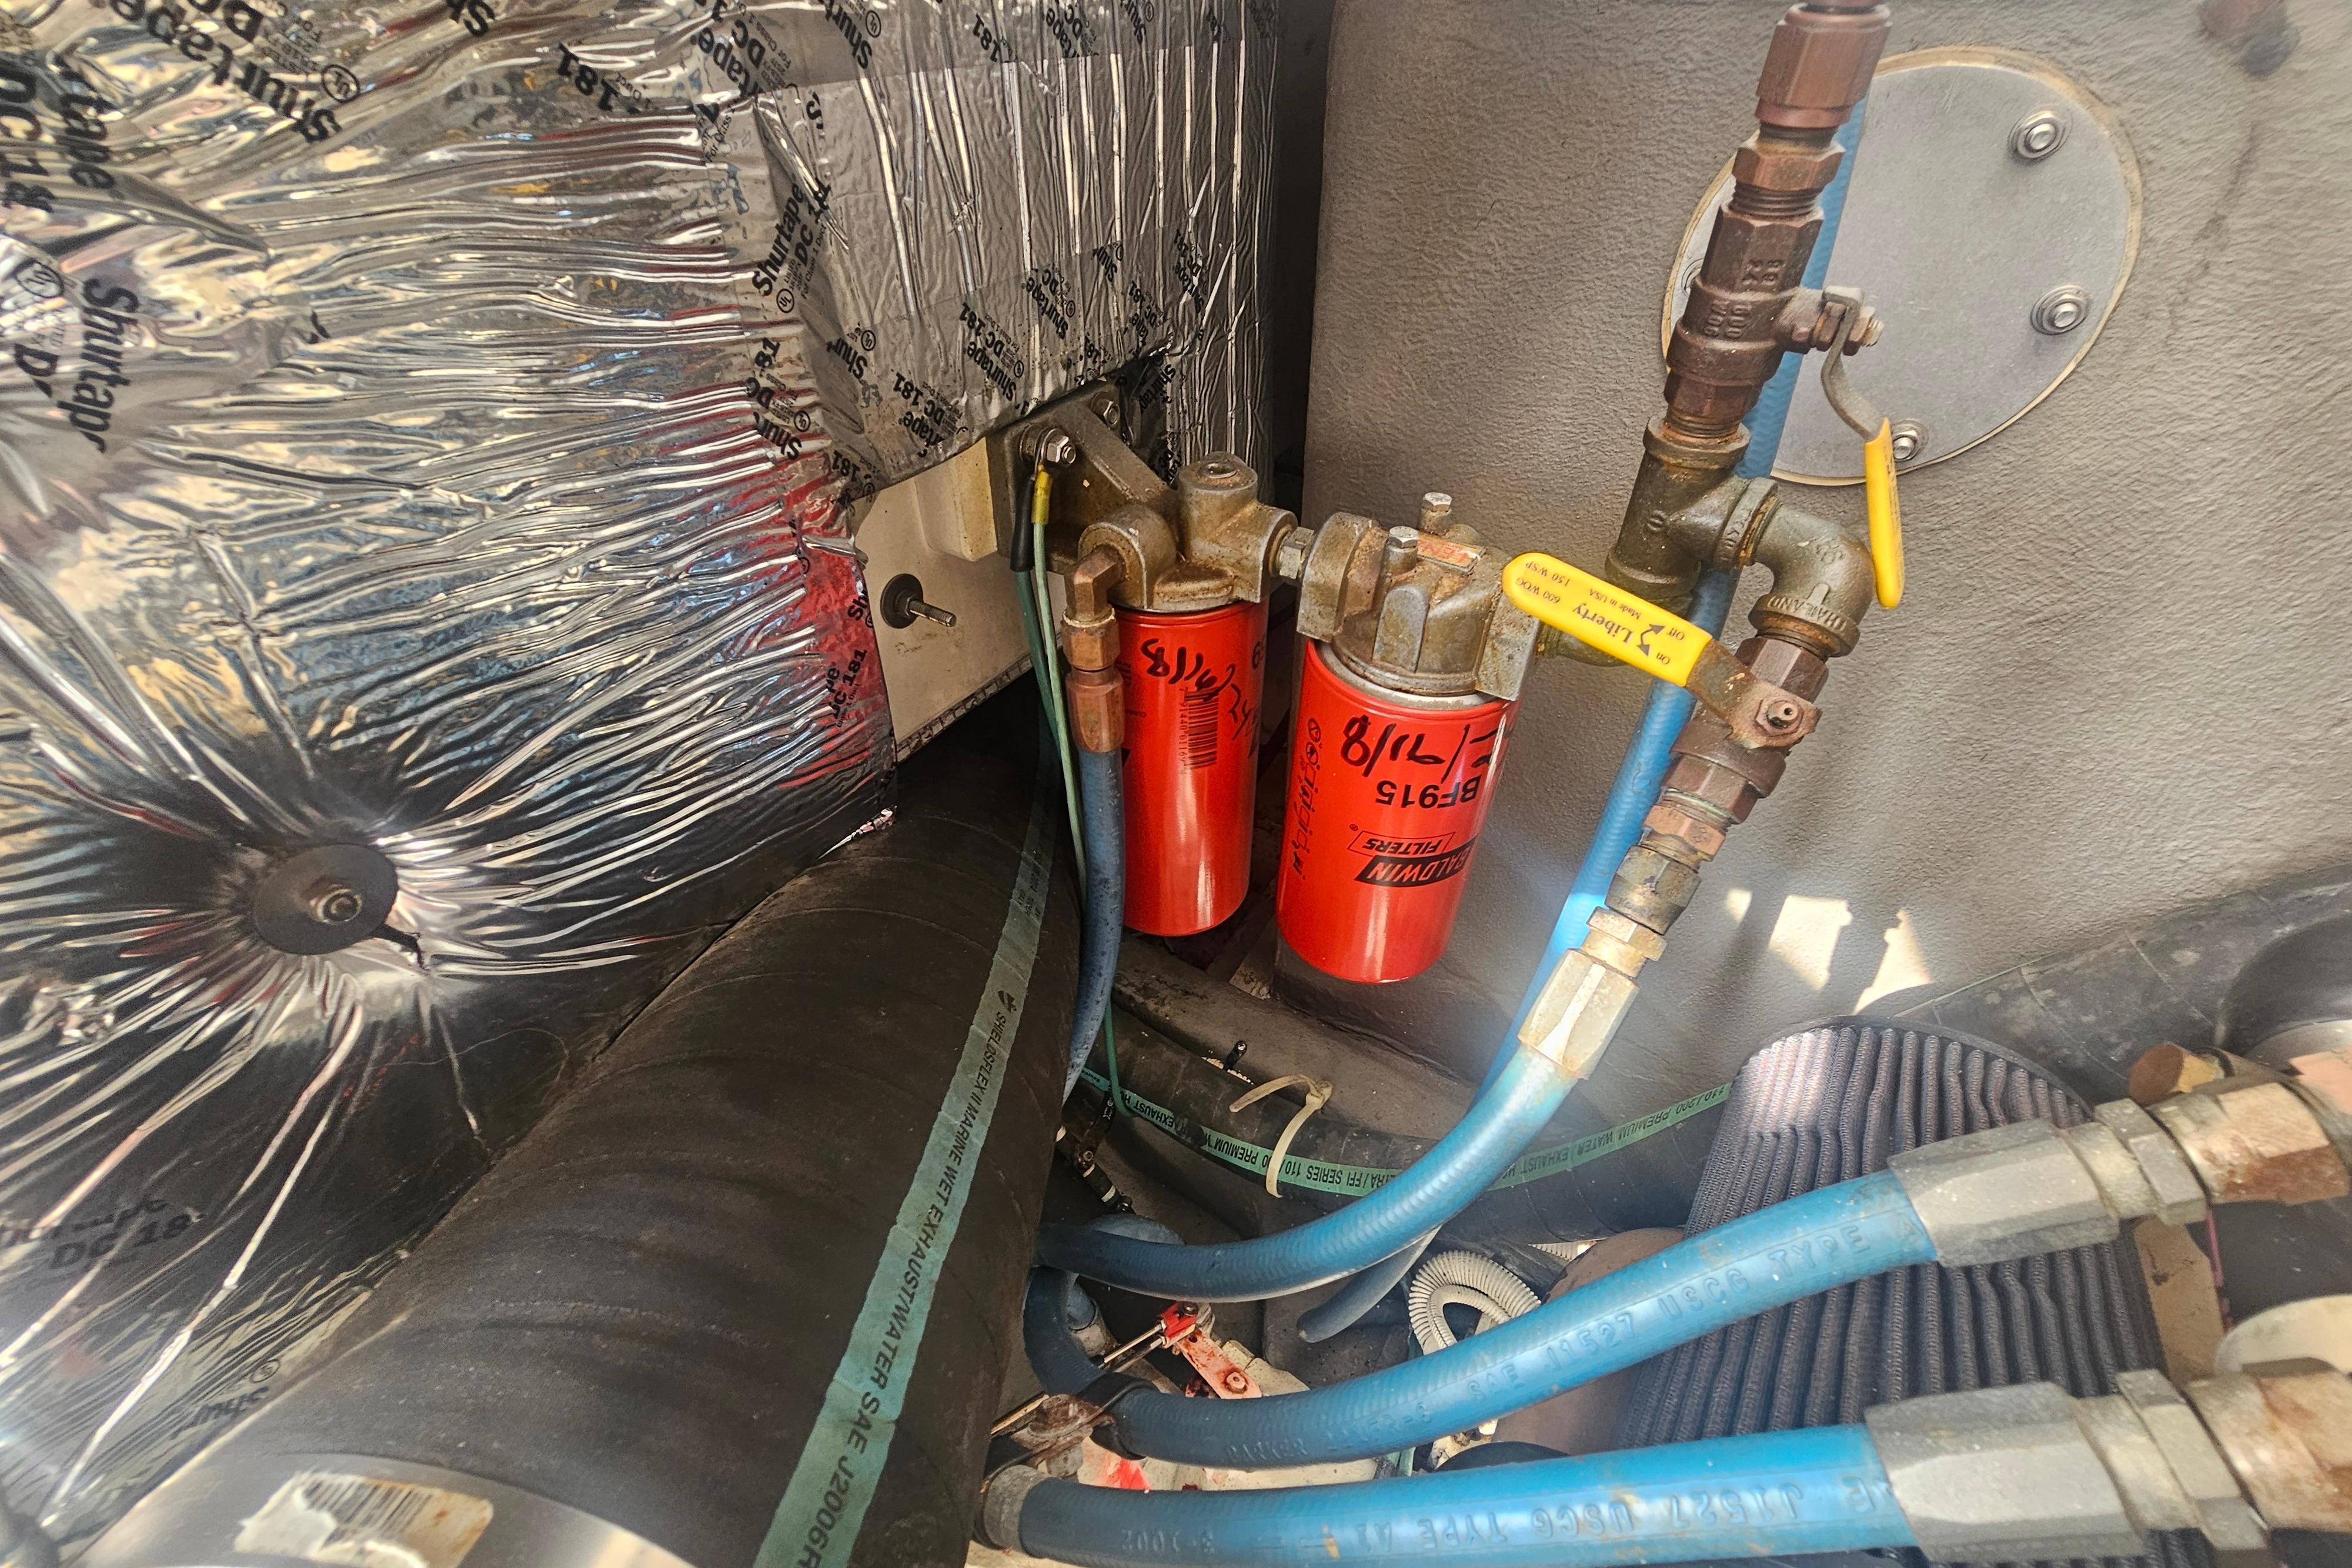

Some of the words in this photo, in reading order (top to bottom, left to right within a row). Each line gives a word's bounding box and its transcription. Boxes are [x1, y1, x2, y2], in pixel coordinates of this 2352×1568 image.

[559, 41, 619, 112] 181
[752, 183, 804, 296] Shurtape
[795, 224, 814, 266] DC
[1041, 269, 1060, 295] DC
[959, 302, 985, 336] 181
[1026, 277, 1069, 340] Shurtape
[985, 331, 1005, 359] DC
[966, 341, 1017, 402] Shurtape
[893, 372, 923, 406] 181
[924, 399, 946, 426] DC
[1525, 561, 1547, 576] WSP
[1552, 572, 1571, 587] 150
[1515, 576, 1540, 595] WOG
[1542, 590, 1561, 604] 600
[1589, 588, 1609, 603] USA
[1609, 597, 1618, 606] in
[1619, 603, 1642, 620] Made
[1572, 603, 1634, 644] Liberty
[1665, 627, 1686, 641] Off
[843, 648, 867, 687] 181
[1656, 651, 1672, 666] On
[1375, 774, 1482, 809] BF915
[1362, 837, 1443, 855] FILTERS
[1368, 849, 1471, 882] BALDWIN
[976, 1011, 1007, 1096] SHIELDSFLEX
[1132, 1101, 1175, 1128] EXHAUST
[1618, 1111, 1669, 1140] PREMIUM
[948, 1102, 980, 1166] MARINE
[1212, 1138, 1259, 1165] PREMIUM
[1522, 1146, 1569, 1175] EXHAUST
[934, 1164, 960, 1207] WET
[1306, 1164, 1344, 1186] SERIES
[1468, 1363, 1525, 1402] SAE
[1659, 1268, 1750, 1321] USCG
[1769, 1225, 1872, 1280] TYPE
[848, 1390, 881, 1455] SAE
[1417, 1512, 1508, 1550] TYPE
[1530, 1501, 1635, 1536] USCG
